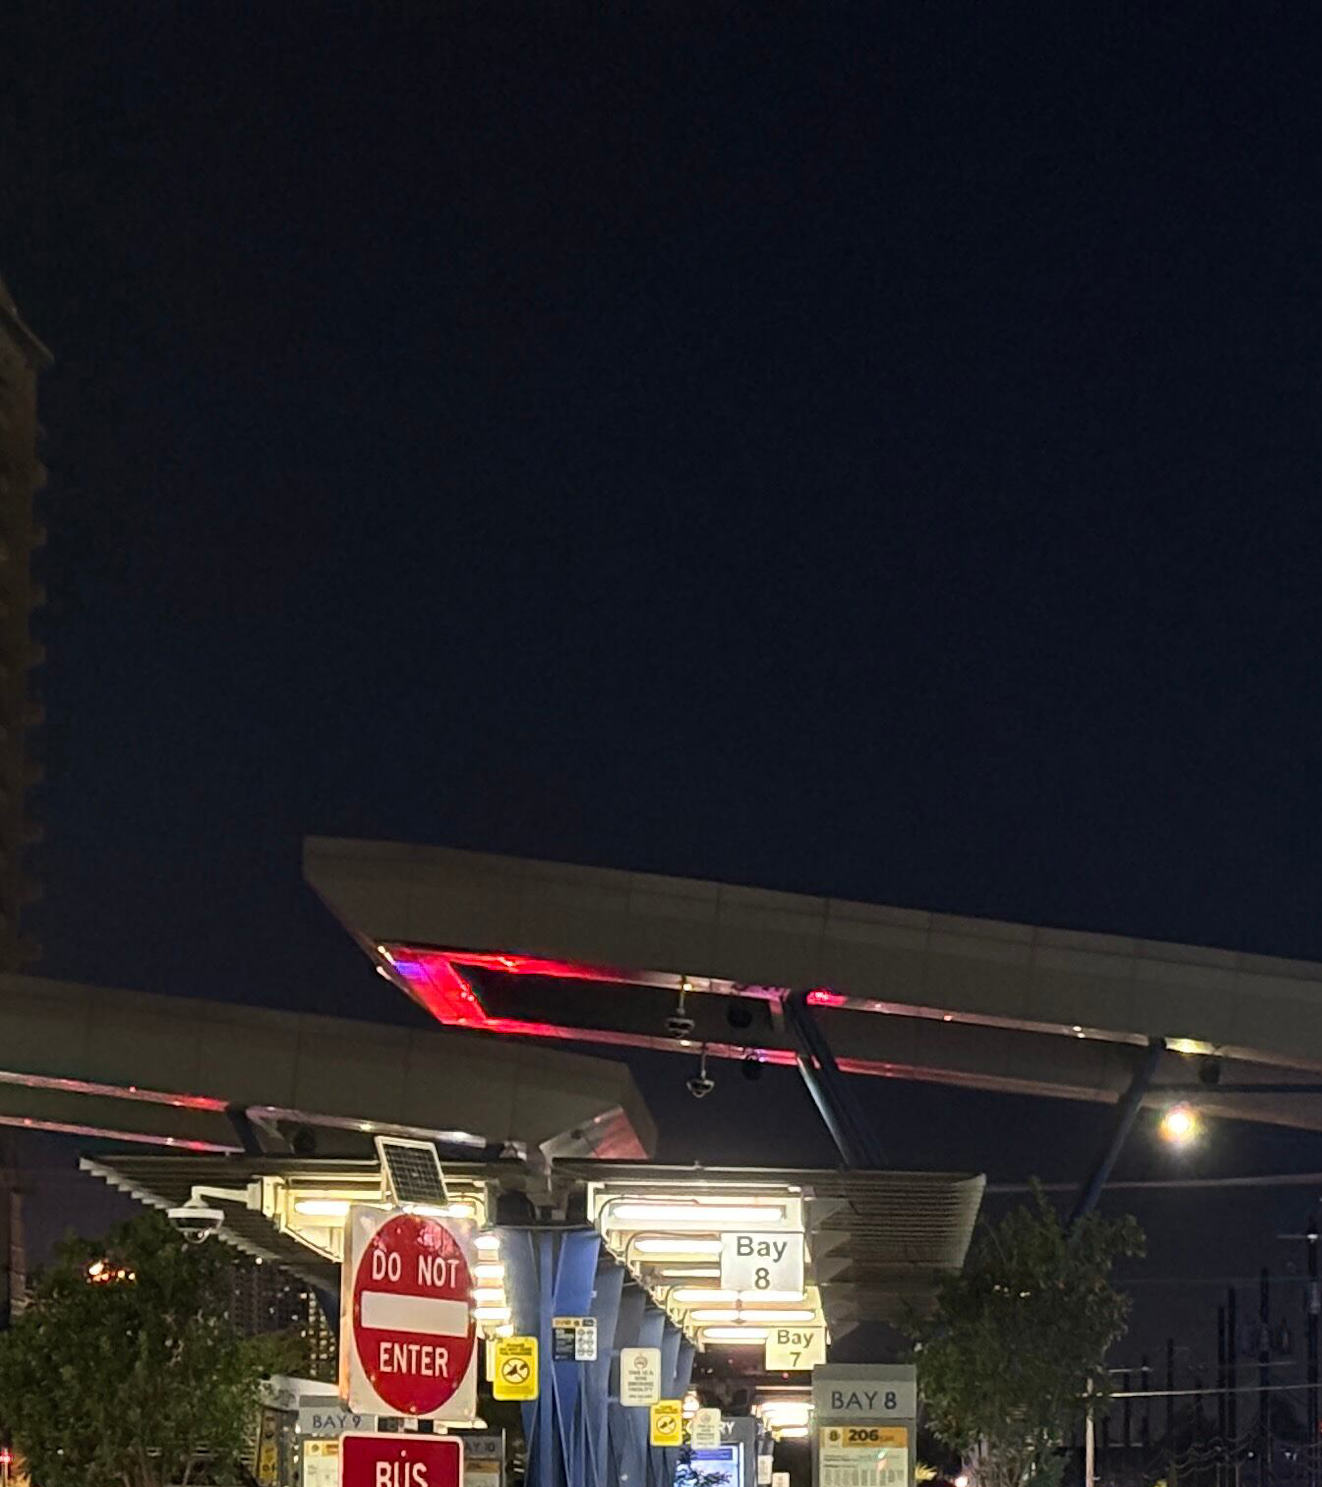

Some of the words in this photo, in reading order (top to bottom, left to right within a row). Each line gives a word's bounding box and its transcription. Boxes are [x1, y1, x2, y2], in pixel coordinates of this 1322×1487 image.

[736, 1235, 787, 1263] Bay
[372, 1249, 401, 1282] DO
[418, 1255, 460, 1289] NOT
[754, 1267, 771, 1290] 8
[777, 1329, 814, 1349] Bay
[379, 1341, 449, 1378] ENTER
[789, 1352, 802, 1367] 7
[831, 1391, 878, 1410] BAY
[884, 1391, 897, 1410] 8
[312, 1415, 347, 1429] BAY
[352, 1415, 362, 1428] 9
[848, 1429, 880, 1442] 206
